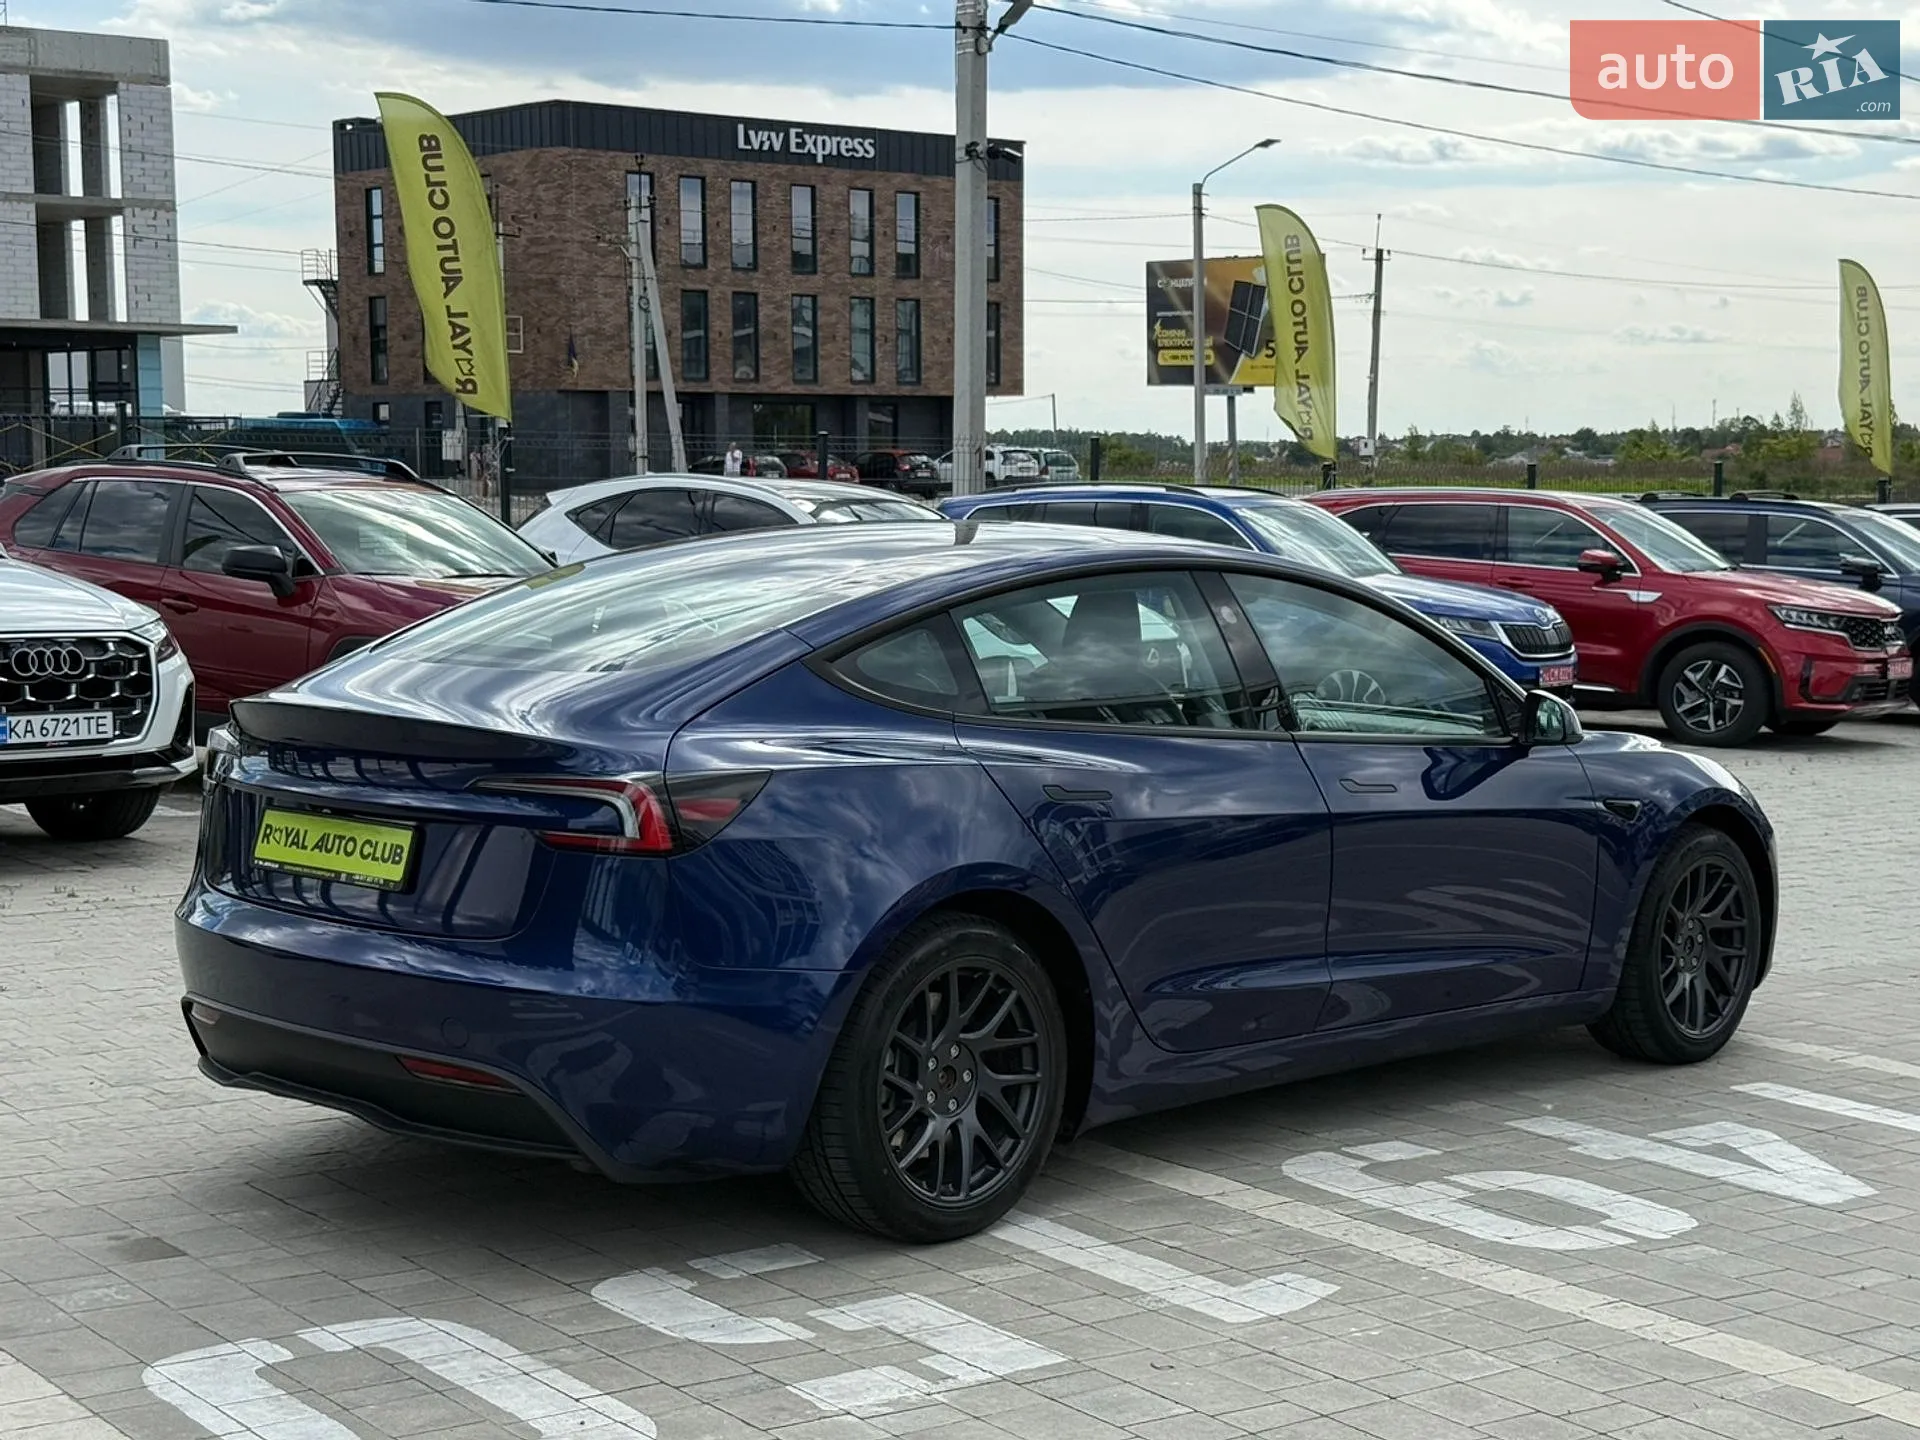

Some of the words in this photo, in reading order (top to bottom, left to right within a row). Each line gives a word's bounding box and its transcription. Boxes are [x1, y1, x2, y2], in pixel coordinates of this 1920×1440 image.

[789, 127, 876, 164] Express
[310, 832, 358, 858] AUTO
[359, 838, 405, 866] CLUB
